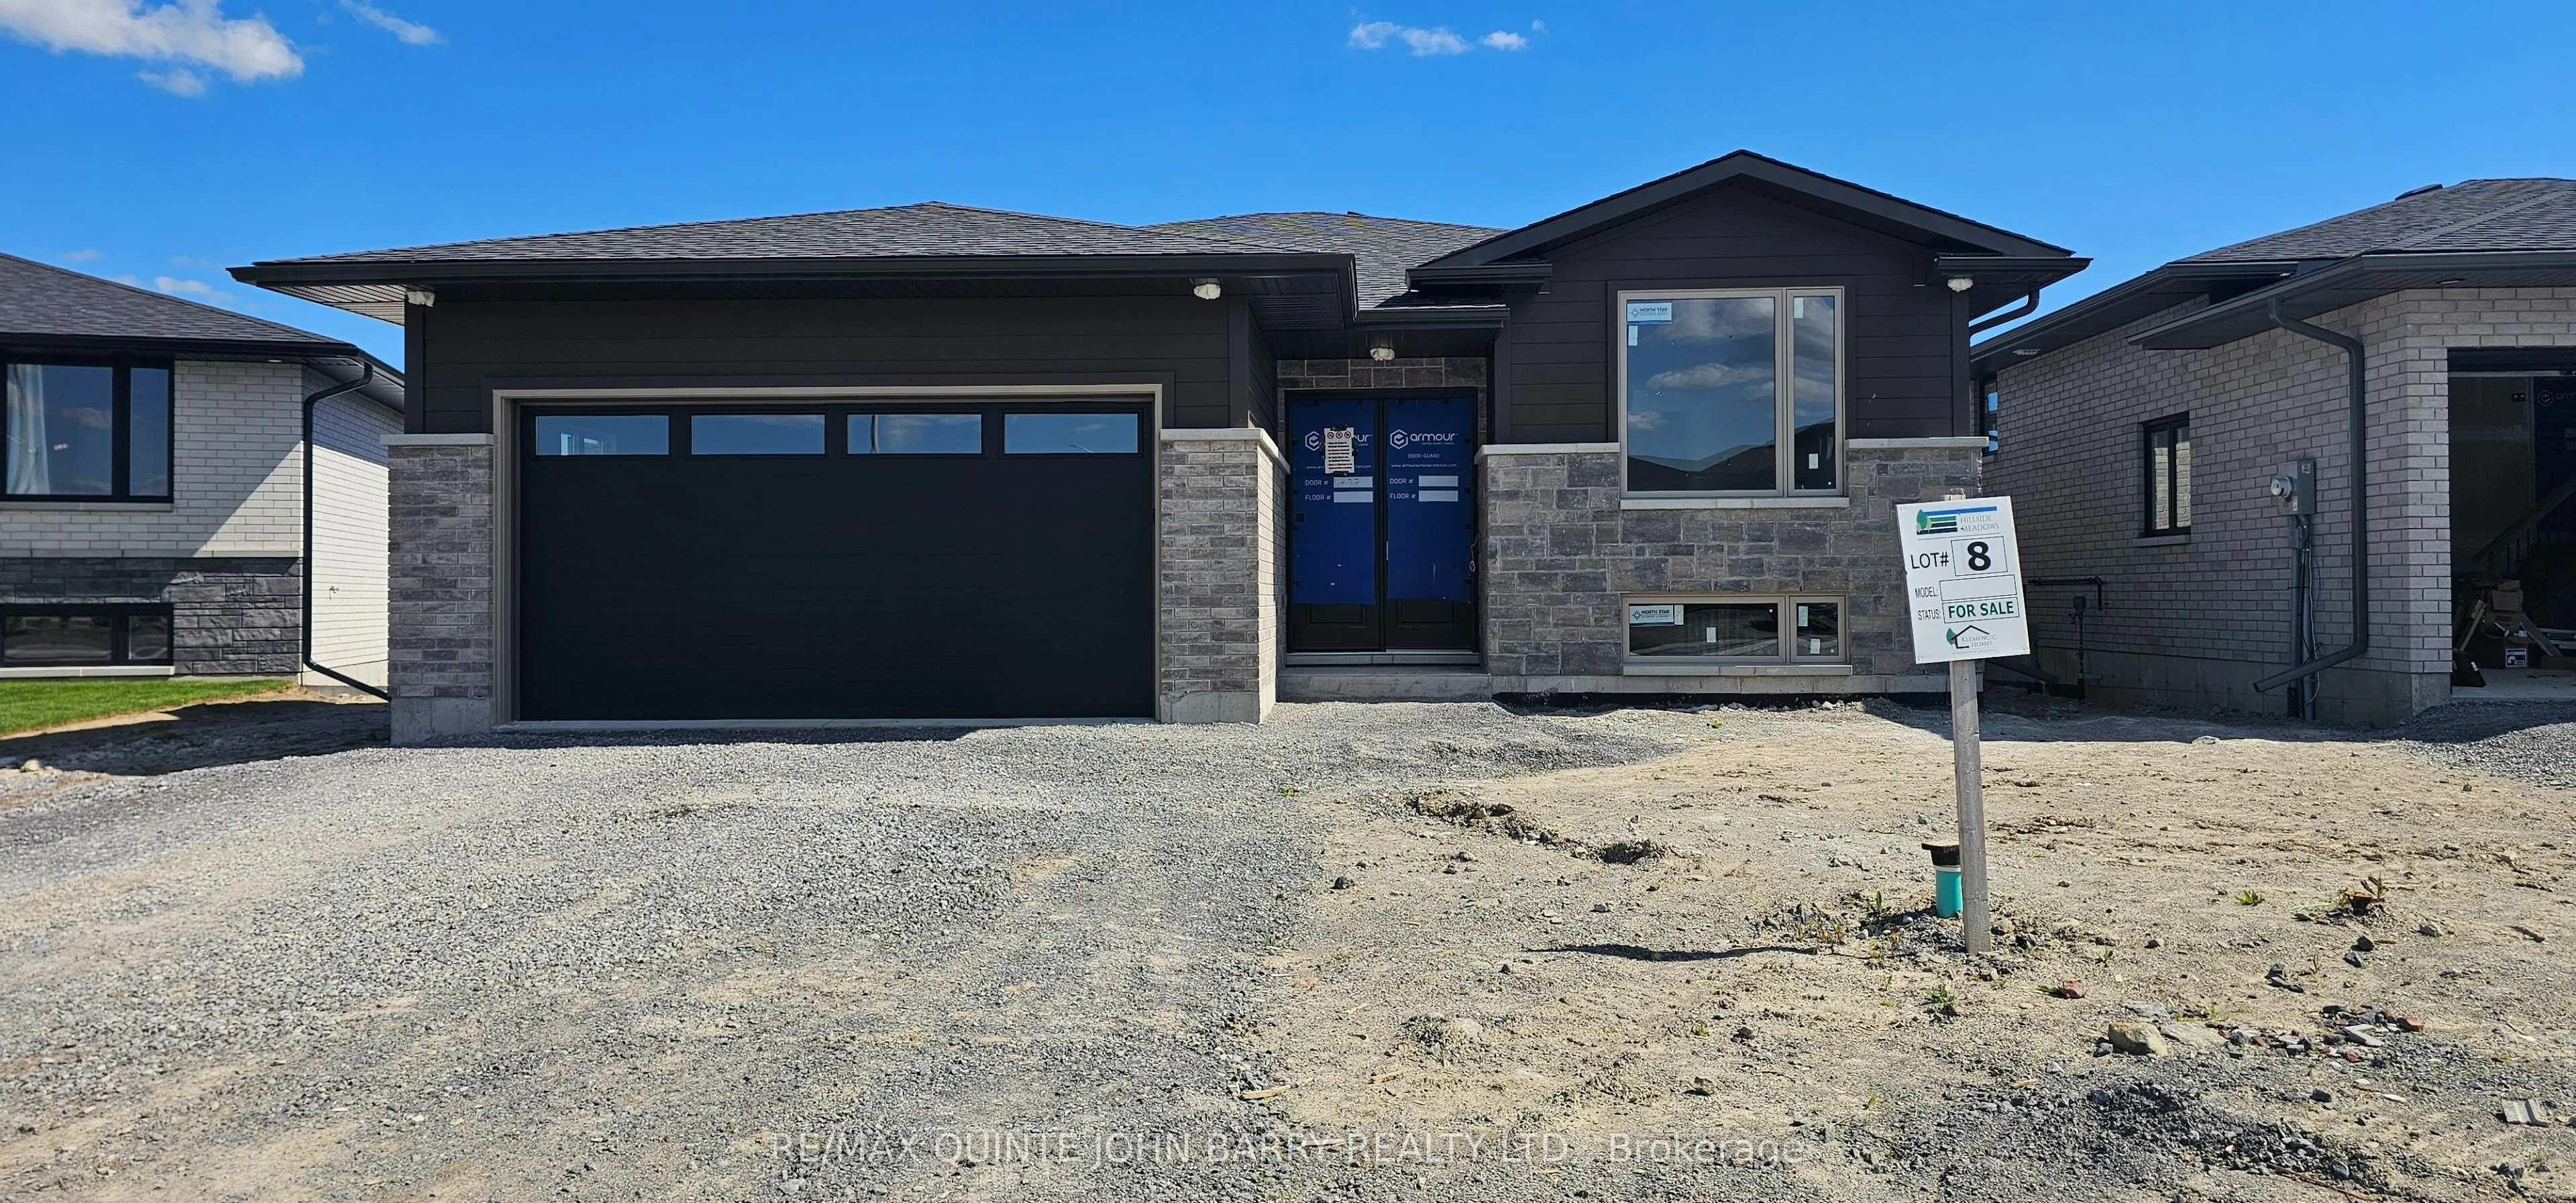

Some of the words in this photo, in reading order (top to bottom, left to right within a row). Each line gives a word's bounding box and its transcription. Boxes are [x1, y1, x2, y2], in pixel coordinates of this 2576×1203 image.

[1409, 433, 1456, 441] armour
[1960, 515, 1992, 523] HILLSIDE
[1962, 523, 2000, 532] MEADOWS
[1911, 551, 1949, 569] LOT#
[1967, 541, 1992, 571] 8
[1915, 586, 1939, 598] MODEL:
[1918, 609, 1941, 621] STATUS:
[1948, 604, 1976, 619] FOR
[1980, 601, 2015, 617] SALE
